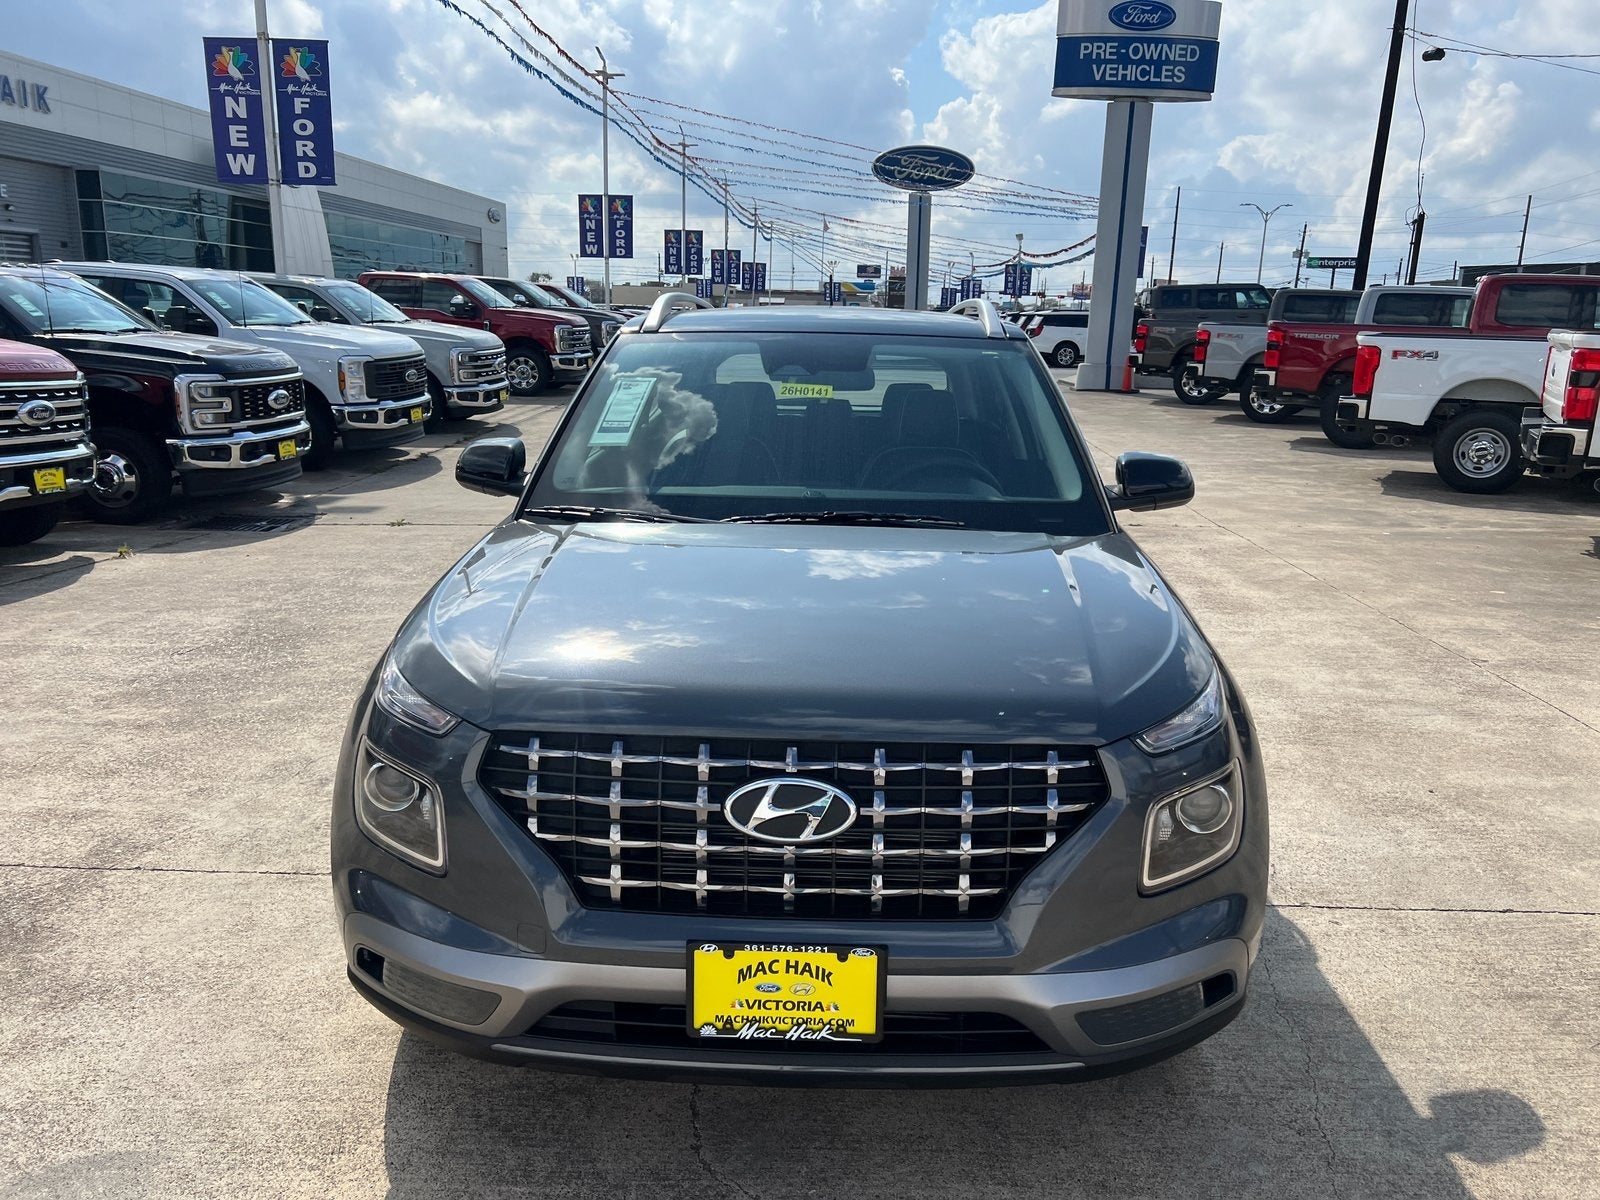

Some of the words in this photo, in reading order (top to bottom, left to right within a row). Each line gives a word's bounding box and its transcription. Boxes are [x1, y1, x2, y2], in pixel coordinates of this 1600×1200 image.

[1123, 4, 1161, 24] Ford
[1079, 42, 1200, 62] PRE-OWNED
[1092, 64, 1186, 83] VEHICLES
[224, 96, 255, 176] NEW
[293, 97, 317, 178] FORD
[892, 153, 954, 181] Ford
[585, 219, 598, 255] NEW
[615, 220, 626, 256] FORD
[668, 247, 678, 273] NEW
[690, 248, 698, 274] FORD
[1310, 259, 1356, 267] enterpris
[714, 263, 722, 283] NEW
[1293, 332, 1340, 341] TREMOR
[1391, 350, 1440, 361] FX4
[780, 386, 829, 397] 26H0141
[32, 407, 50, 419] Ford
[744, 944, 829, 954] 361-576-1221
[852, 949, 874, 957] Ford
[737, 959, 780, 984] MAC
[785, 959, 834, 987] HAIK
[758, 983, 778, 993] Ford
[745, 999, 826, 1012] VICTORIA
[714, 1014, 855, 1027] MACHAIKVICTORIACOM
[736, 1022, 783, 1040] Mac
[784, 1024, 835, 1041] Haik
